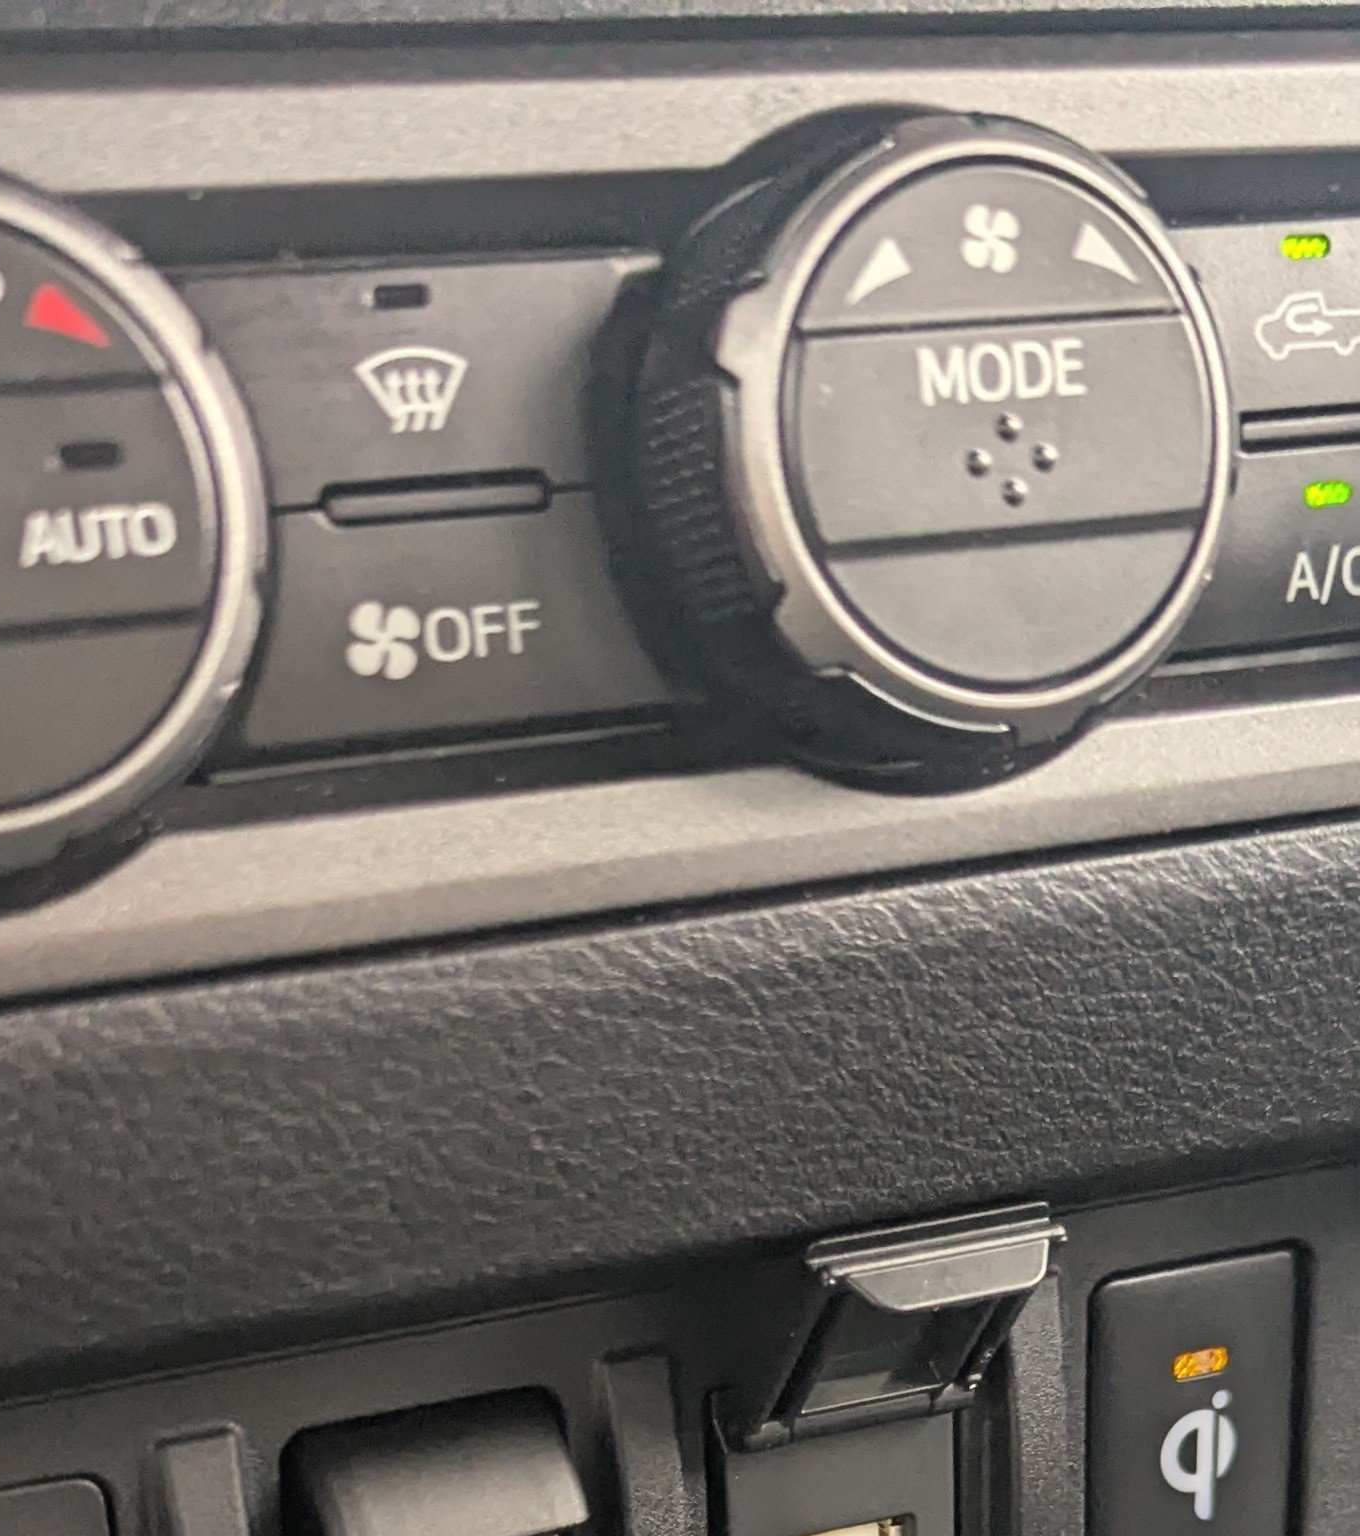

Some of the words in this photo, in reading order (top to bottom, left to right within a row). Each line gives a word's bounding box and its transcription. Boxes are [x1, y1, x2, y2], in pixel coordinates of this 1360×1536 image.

[916, 338, 1087, 407] MODE
[19, 502, 177, 568] AUTO
[423, 600, 542, 664] OFF
